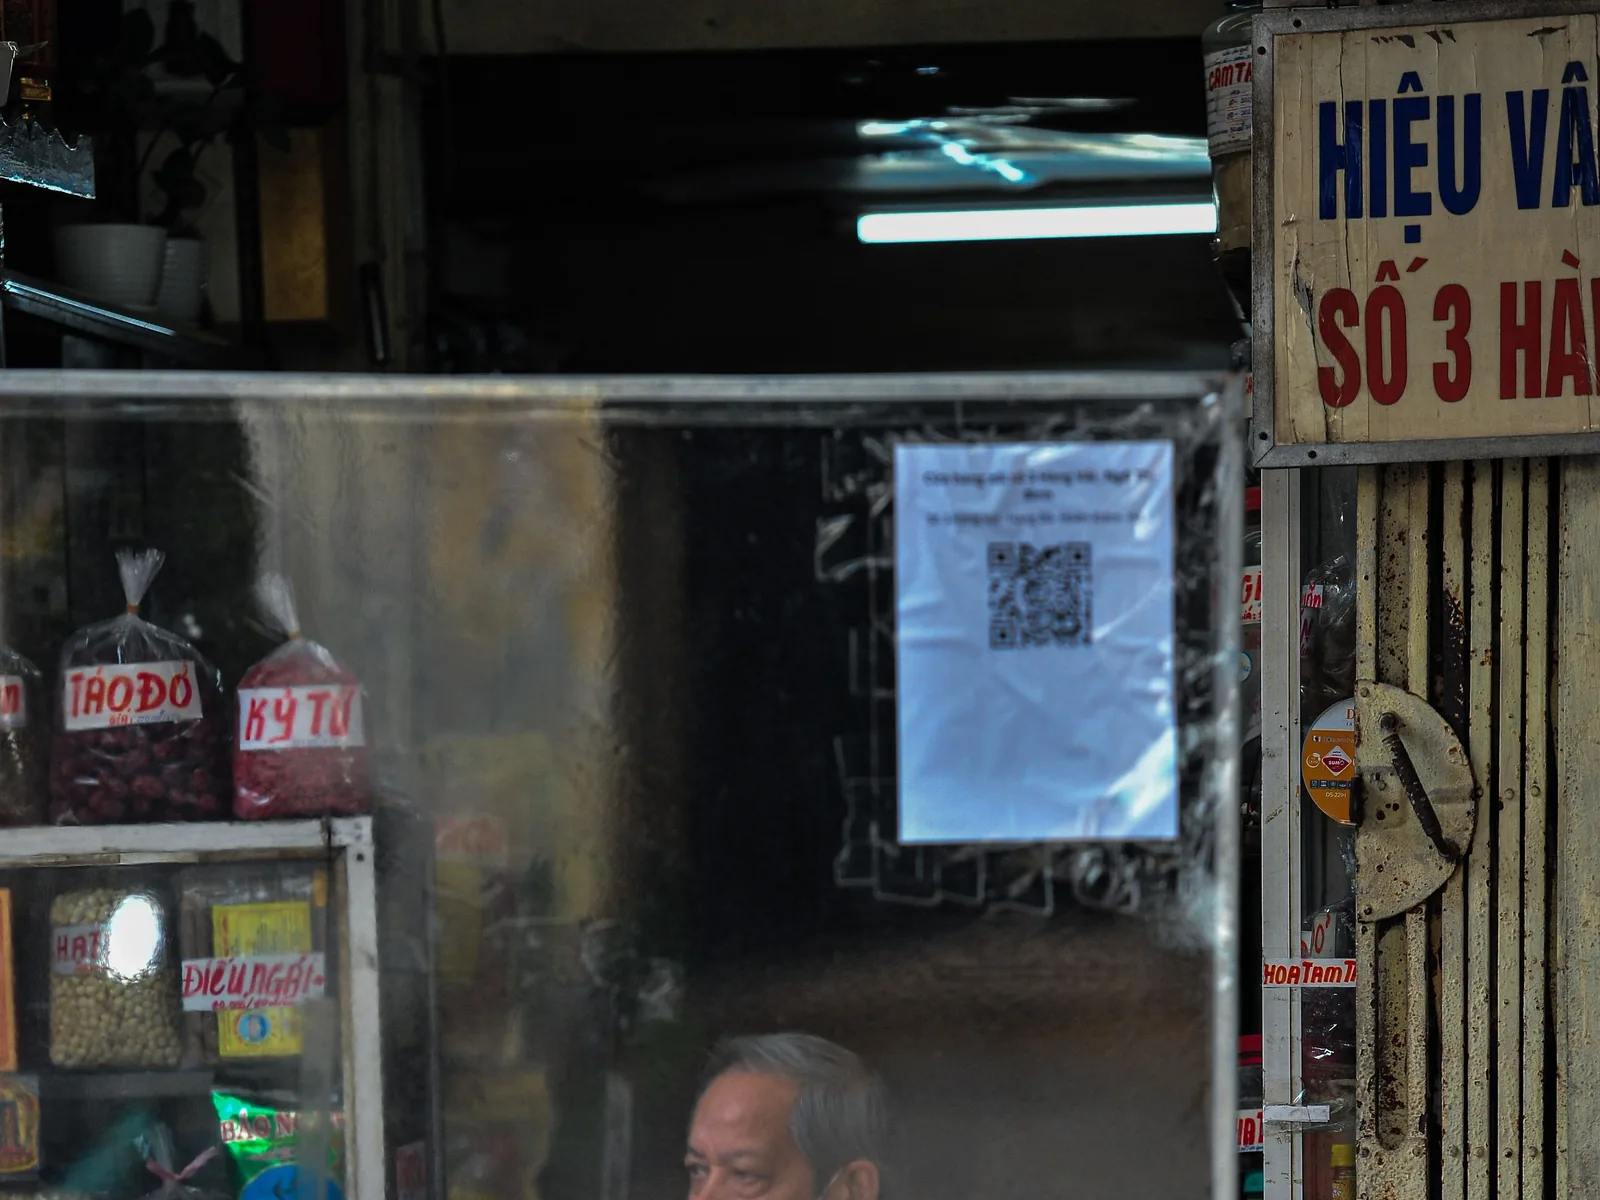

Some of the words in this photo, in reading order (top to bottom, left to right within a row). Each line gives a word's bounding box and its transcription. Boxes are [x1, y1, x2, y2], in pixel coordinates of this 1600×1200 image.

[1319, 71, 1482, 243] HIỆU
[1318, 256, 1428, 408] SỐ
[1433, 283, 1472, 403] 3
[1263, 964, 1300, 985] HOA
